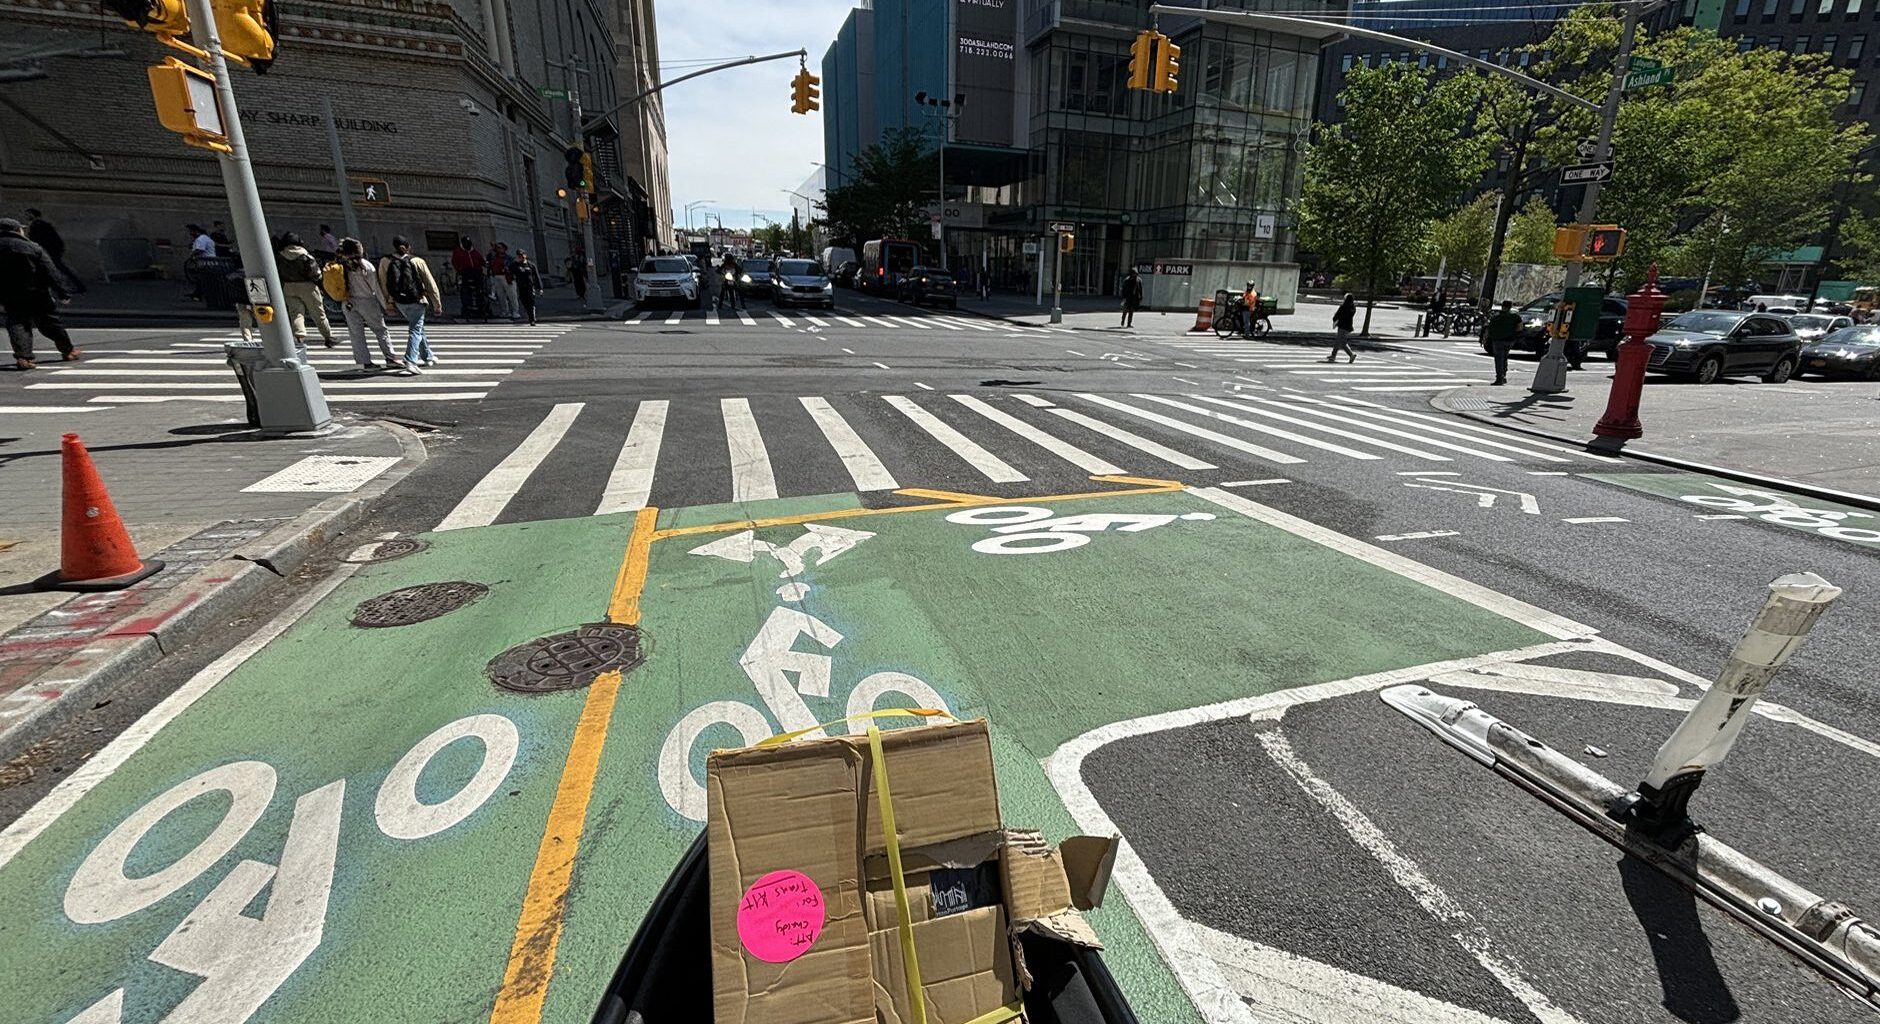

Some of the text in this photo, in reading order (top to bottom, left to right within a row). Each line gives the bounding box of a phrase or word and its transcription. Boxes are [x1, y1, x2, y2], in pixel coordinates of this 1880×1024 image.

[1628, 71, 1662, 88] Ashland
[267, 112, 320, 127] SHARP
[1568, 169, 1606, 179] ONE WAY
[1165, 265, 1190, 274] PARK
